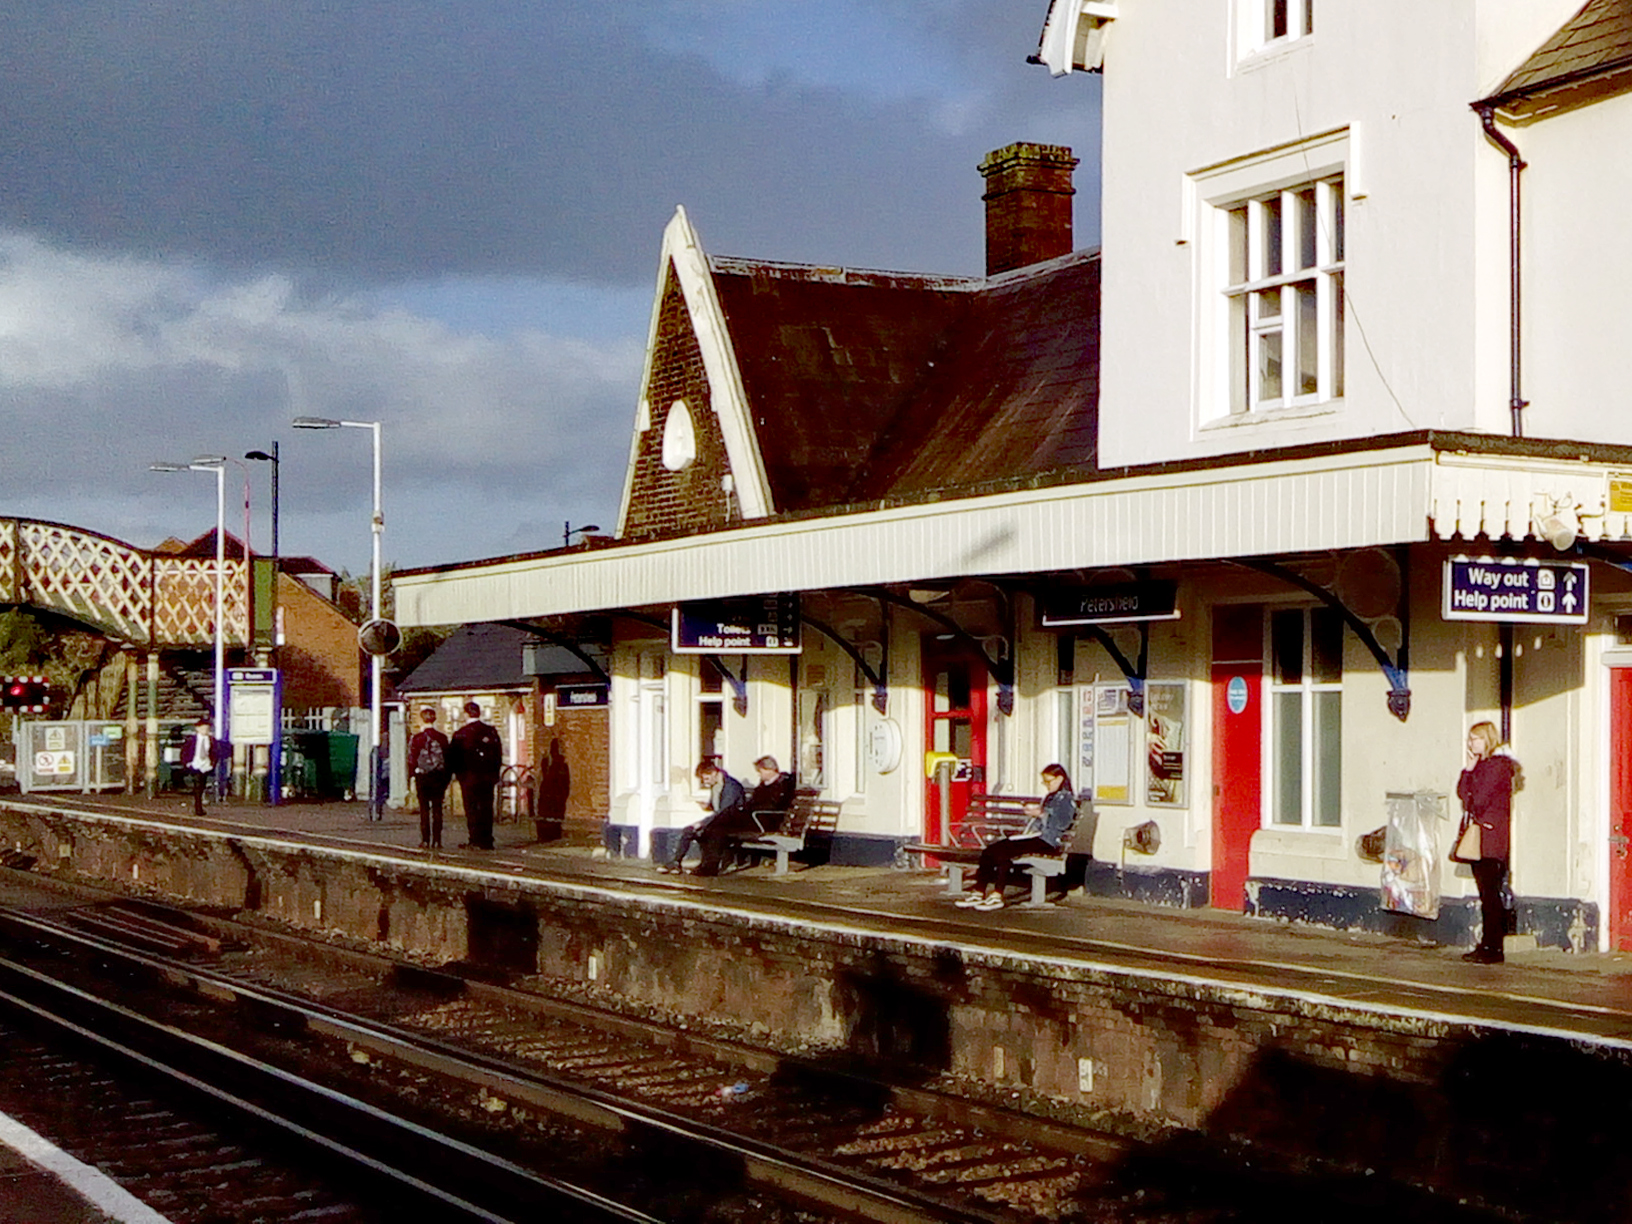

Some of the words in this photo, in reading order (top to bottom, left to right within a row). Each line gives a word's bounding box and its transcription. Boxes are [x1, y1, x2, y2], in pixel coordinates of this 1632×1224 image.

[1468, 567, 1502, 590] Way
[1503, 570, 1530, 588] out
[1453, 589, 1489, 612] Help
[1490, 592, 1530, 613] point
[698, 635, 723, 648] Help
[723, 637, 752, 649] point
